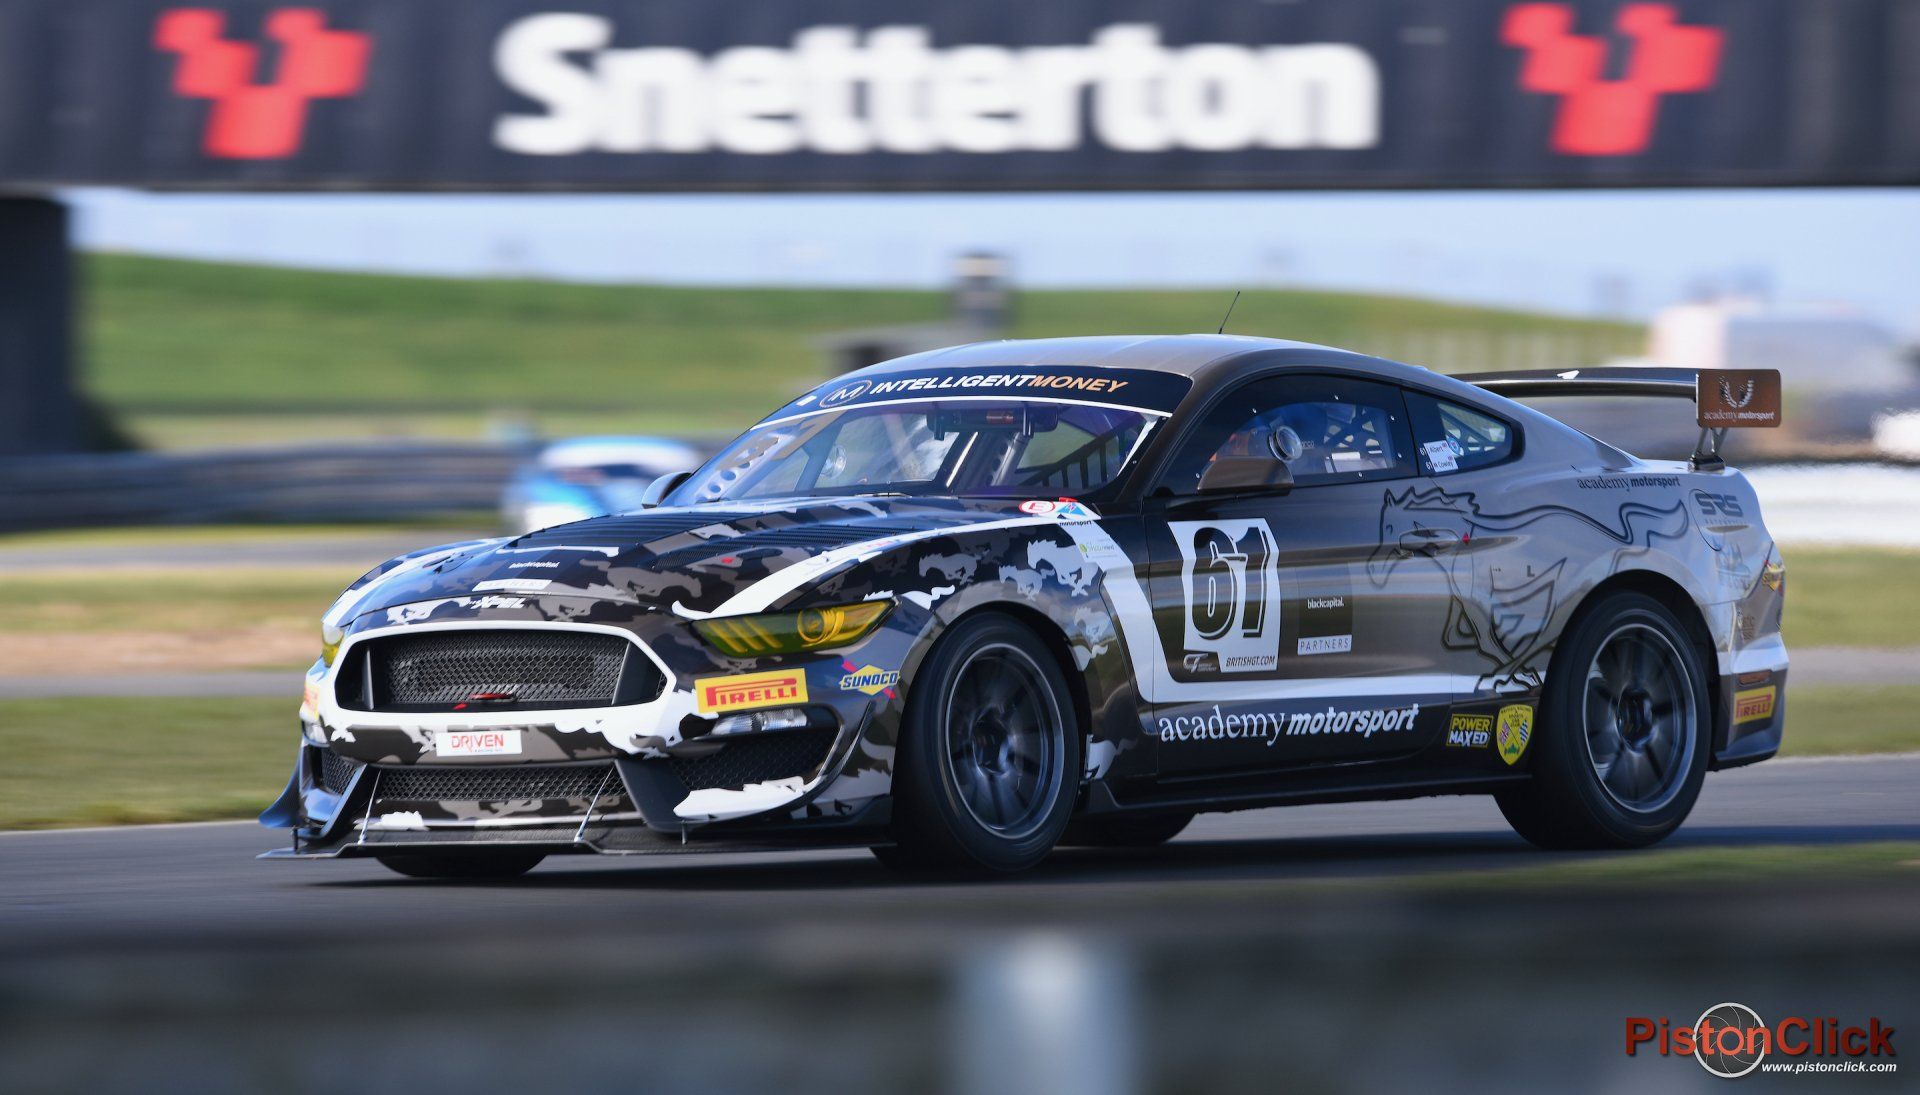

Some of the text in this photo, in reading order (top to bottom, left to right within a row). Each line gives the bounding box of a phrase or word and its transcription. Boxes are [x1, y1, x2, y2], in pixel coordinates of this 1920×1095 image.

[494, 11, 1382, 155] Snetterton
[1577, 475, 1681, 491] academy motorsport
[1694, 493, 1744, 518] SRS
[1191, 526, 1271, 641] 61
[1300, 637, 1349, 650] PARTNERS
[1225, 655, 1276, 667] BRITISHGT.COM
[842, 671, 898, 689] SUNOCO
[706, 677, 798, 707] PIRELLI
[1736, 693, 1772, 719] PIRELLI
[1158, 703, 1420, 746] academy motorsport
[1451, 717, 1491, 732] POWER
[451, 733, 504, 752] DRIVEN
[1448, 729, 1489, 747] MAXED
